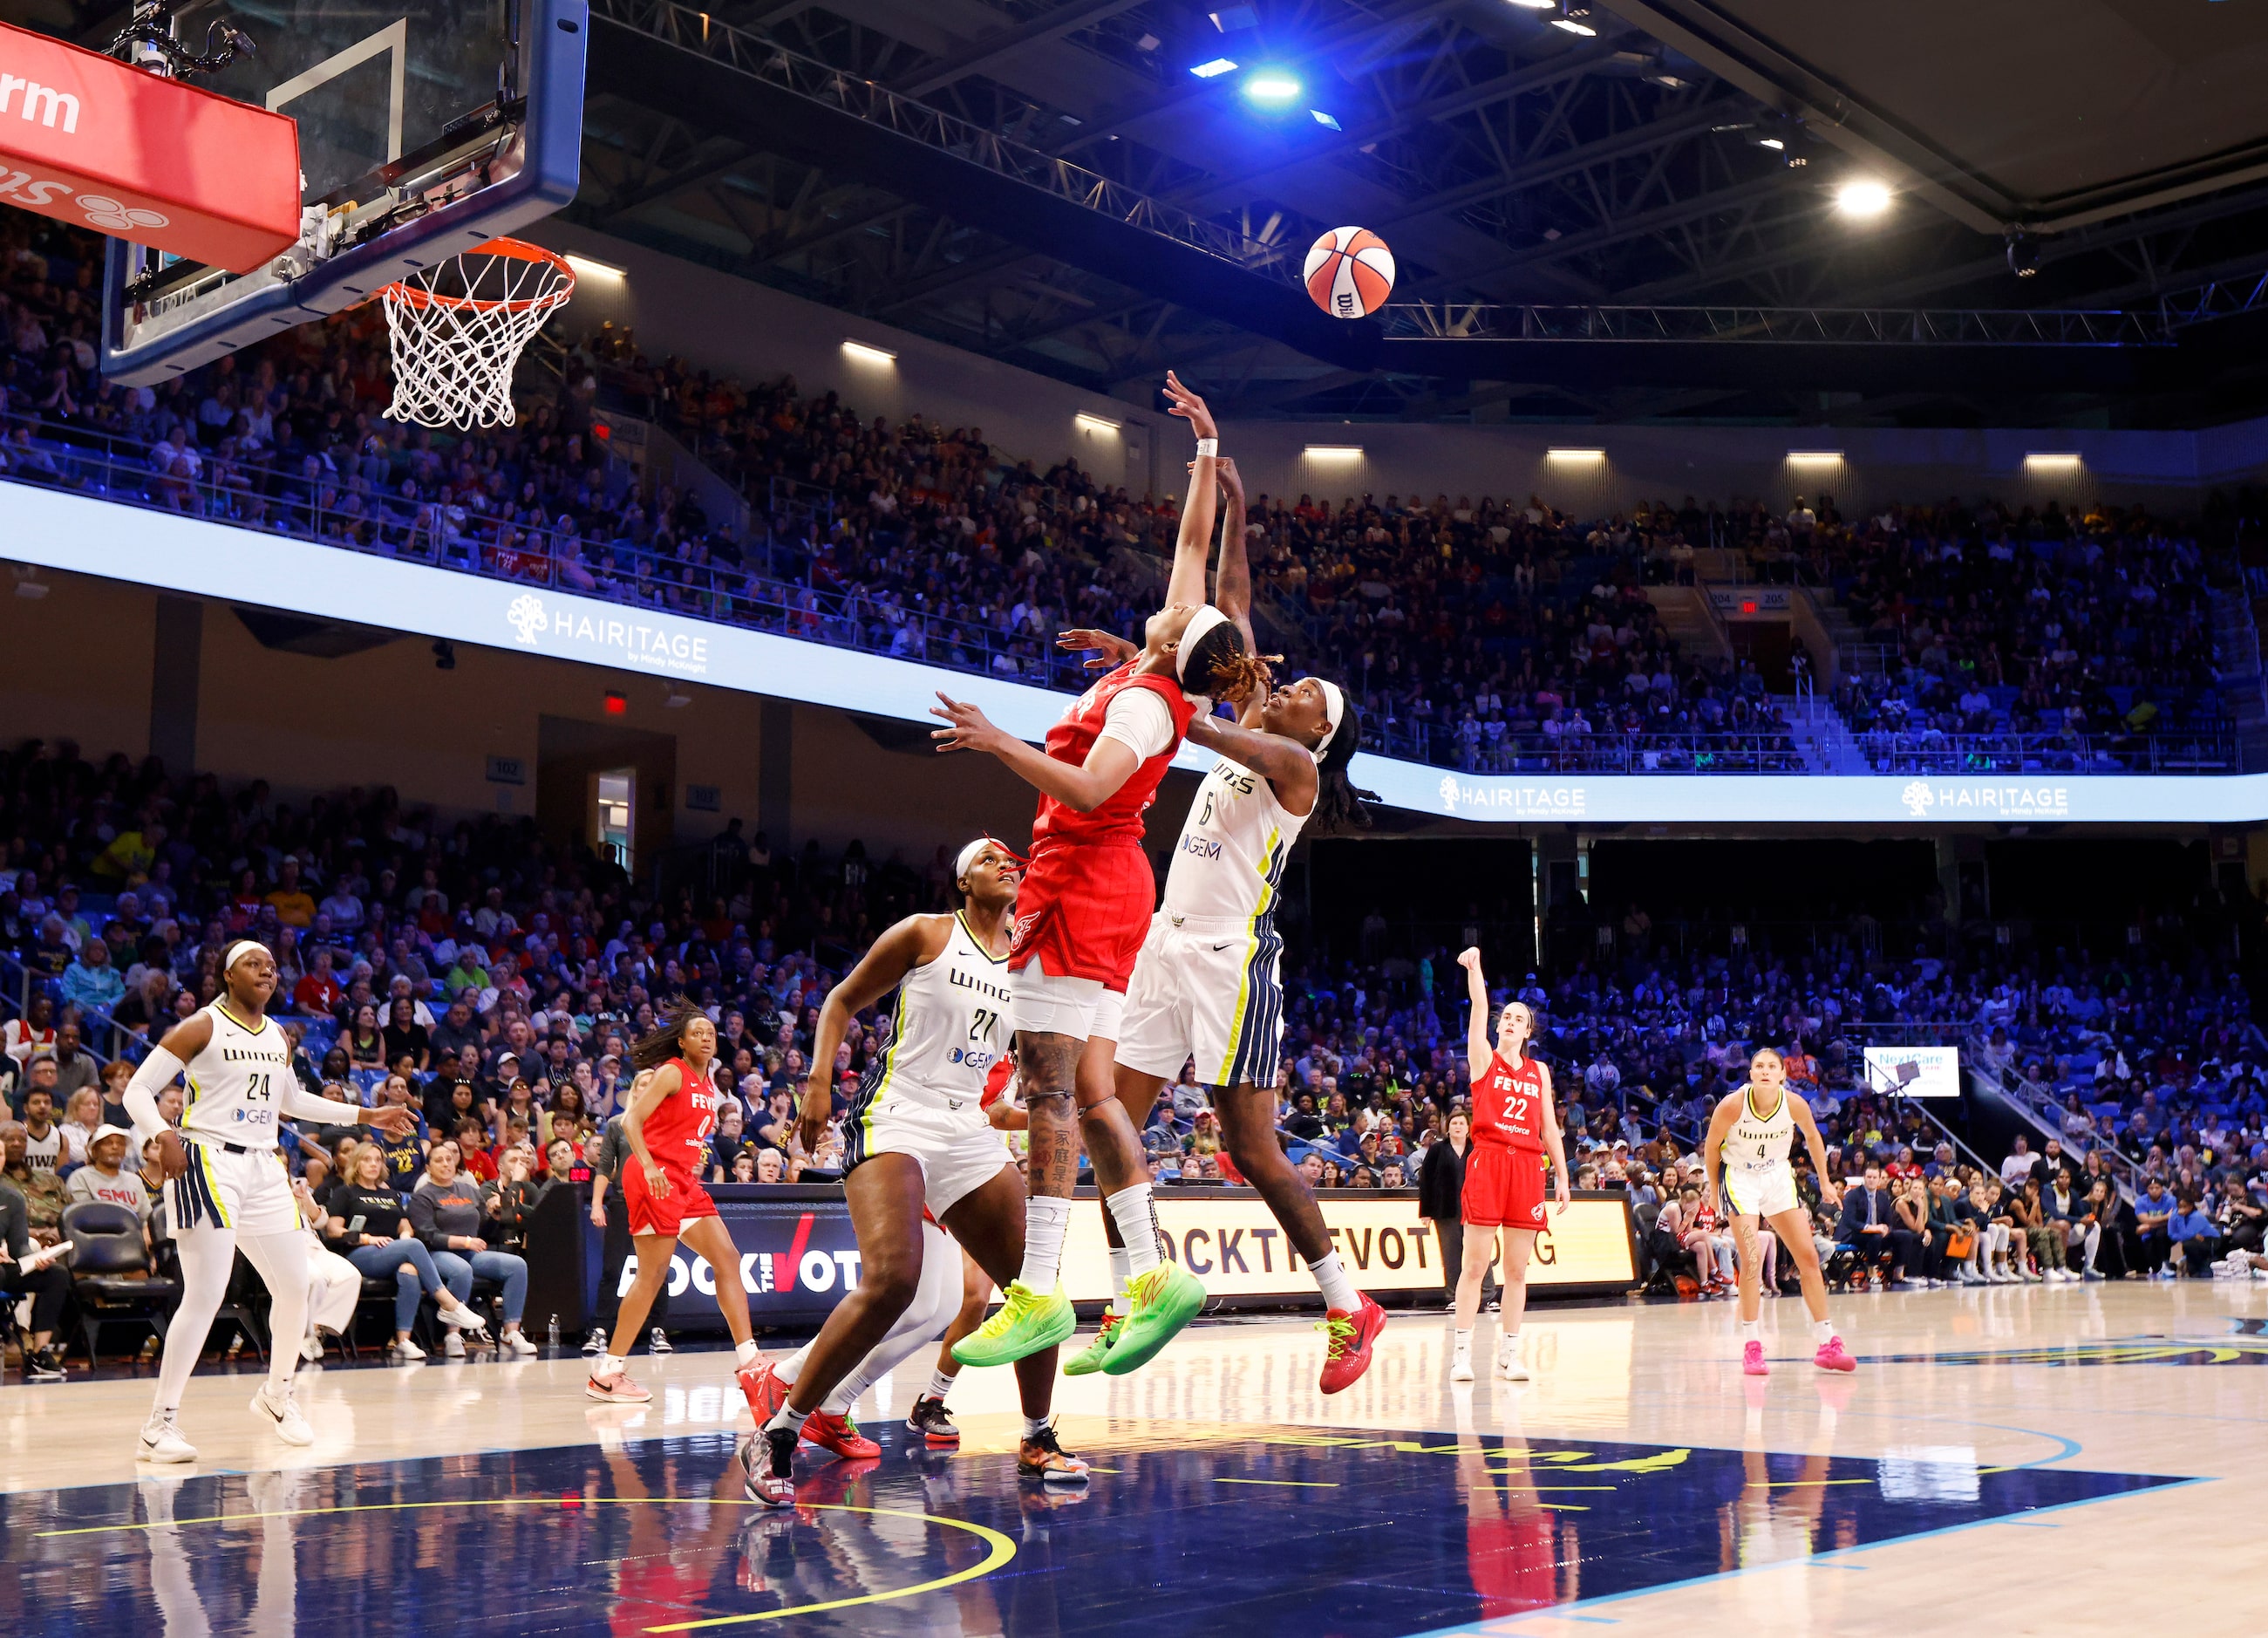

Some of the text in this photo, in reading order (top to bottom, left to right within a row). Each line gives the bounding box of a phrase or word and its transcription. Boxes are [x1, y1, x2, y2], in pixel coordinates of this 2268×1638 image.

[555, 611, 708, 663] HAIRITAGE
[627, 651, 707, 674] by Mindy McKnight
[1462, 787, 1585, 807] HAIRITAGE
[1939, 788, 2067, 807] HAIRITAGE
[1188, 836, 1223, 861] GEM
[970, 1008, 998, 1042] 21
[1879, 1053, 1943, 1066] NextCare
[247, 1073, 270, 1102] 24
[1494, 1075, 1539, 1099] FEVER
[1502, 1095, 1528, 1121] 22
[697, 1115, 712, 1138] 0
[1494, 1122, 1530, 1136] salesforce
[1757, 1143, 1766, 1159] 4
[396, 1153, 414, 1173] 22
[97, 1189, 138, 1206] SMU
